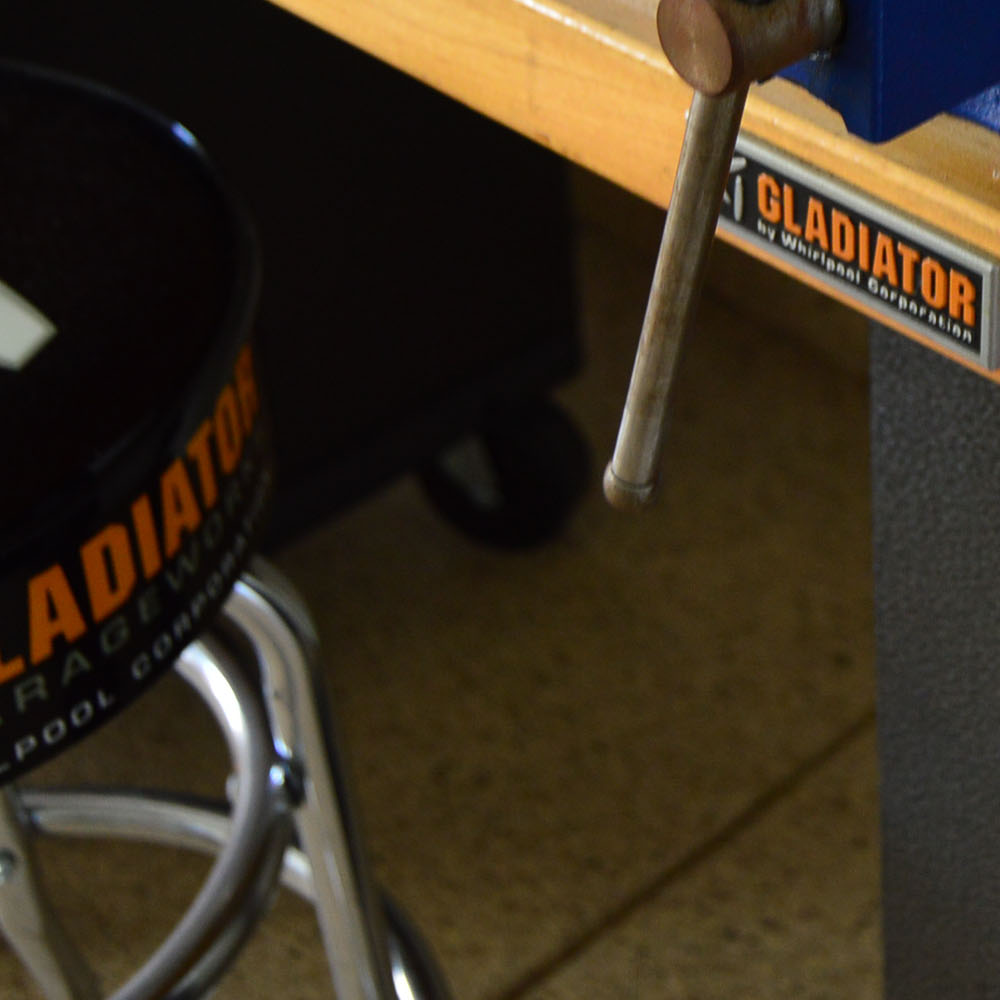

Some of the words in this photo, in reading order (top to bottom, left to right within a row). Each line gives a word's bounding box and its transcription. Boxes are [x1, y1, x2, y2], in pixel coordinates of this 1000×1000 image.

[757, 172, 977, 327] GLADIATOR
[757, 218, 777, 243] by
[780, 230, 861, 285] Whirlpool
[867, 275, 974, 344] Corporation
[0, 343, 261, 684] ADIATOR
